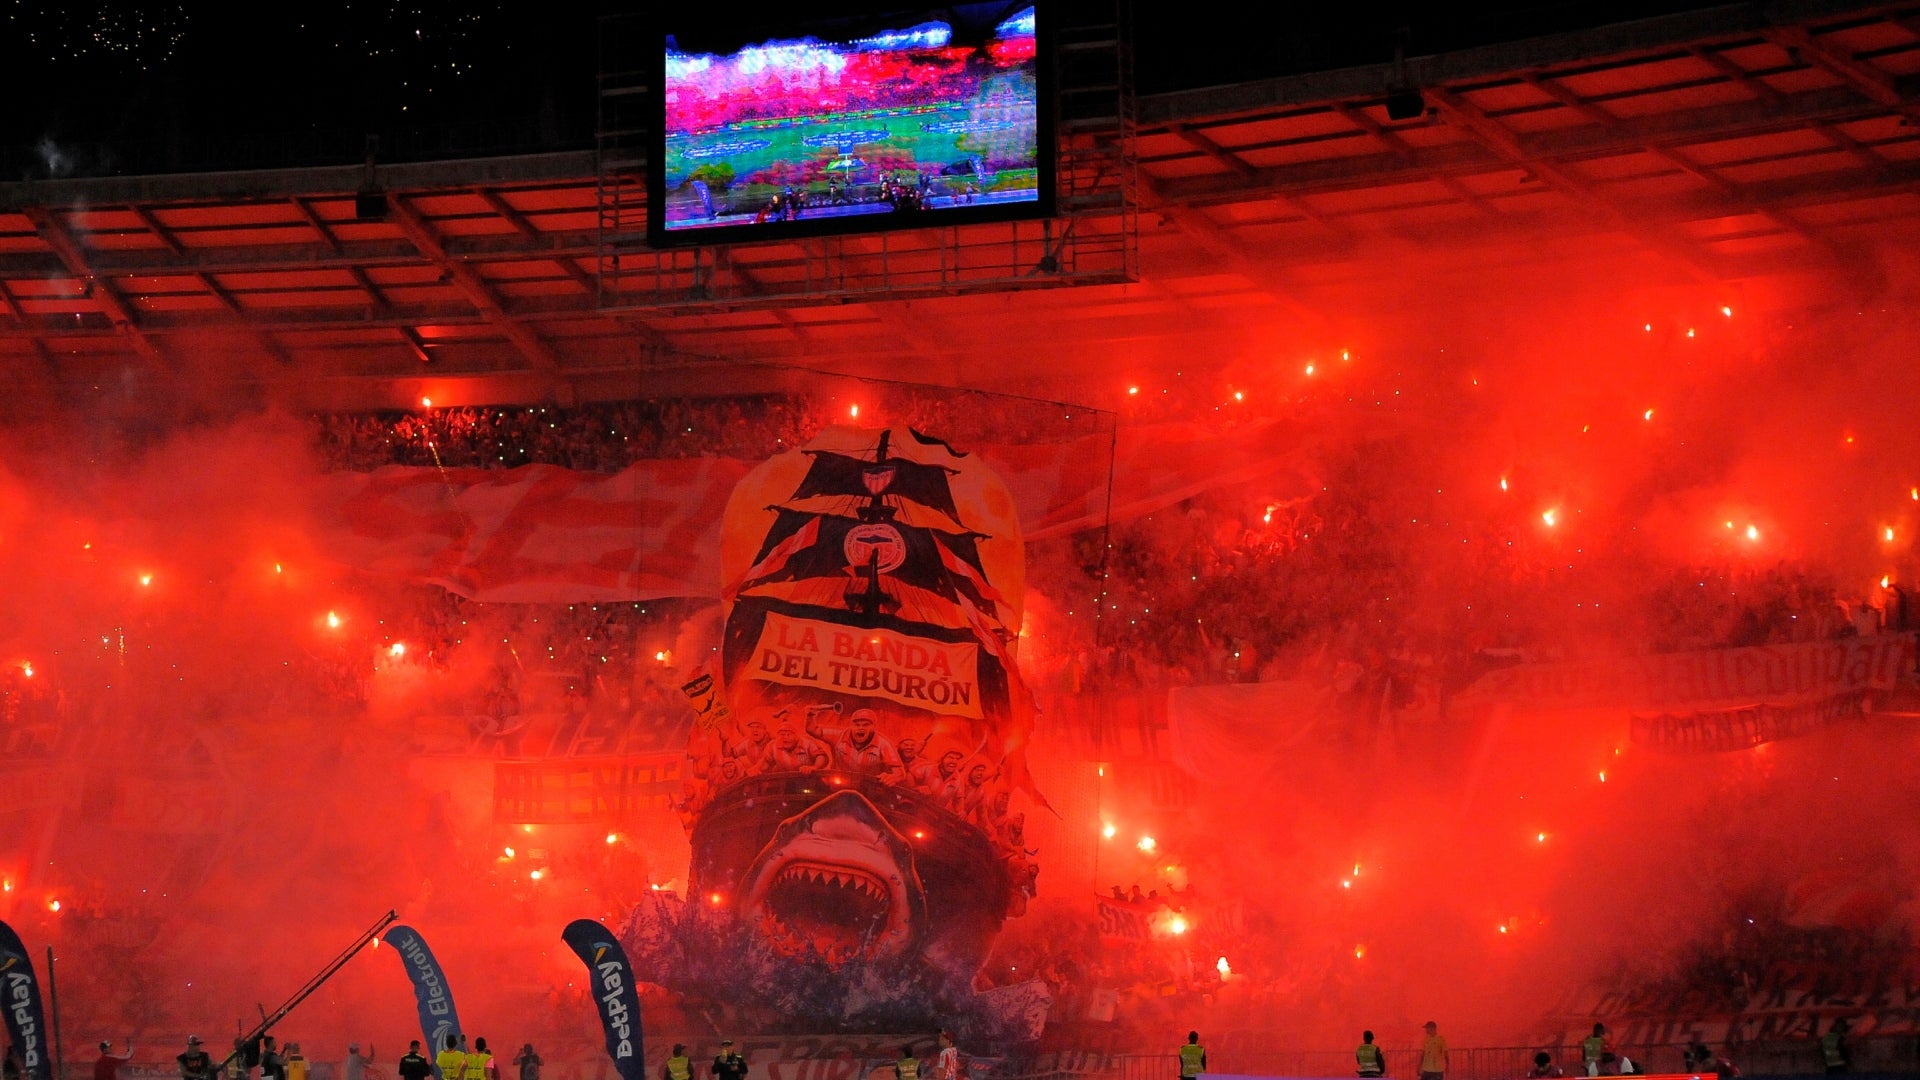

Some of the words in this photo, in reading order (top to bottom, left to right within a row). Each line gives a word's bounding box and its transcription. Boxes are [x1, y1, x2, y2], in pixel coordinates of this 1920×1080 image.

[759, 648, 818, 681] DEL
[828, 660, 972, 706] TIBURÓN
[777, 623, 819, 652] LA
[833, 631, 953, 677] BANDA
[401, 934, 449, 1015] Electrolit
